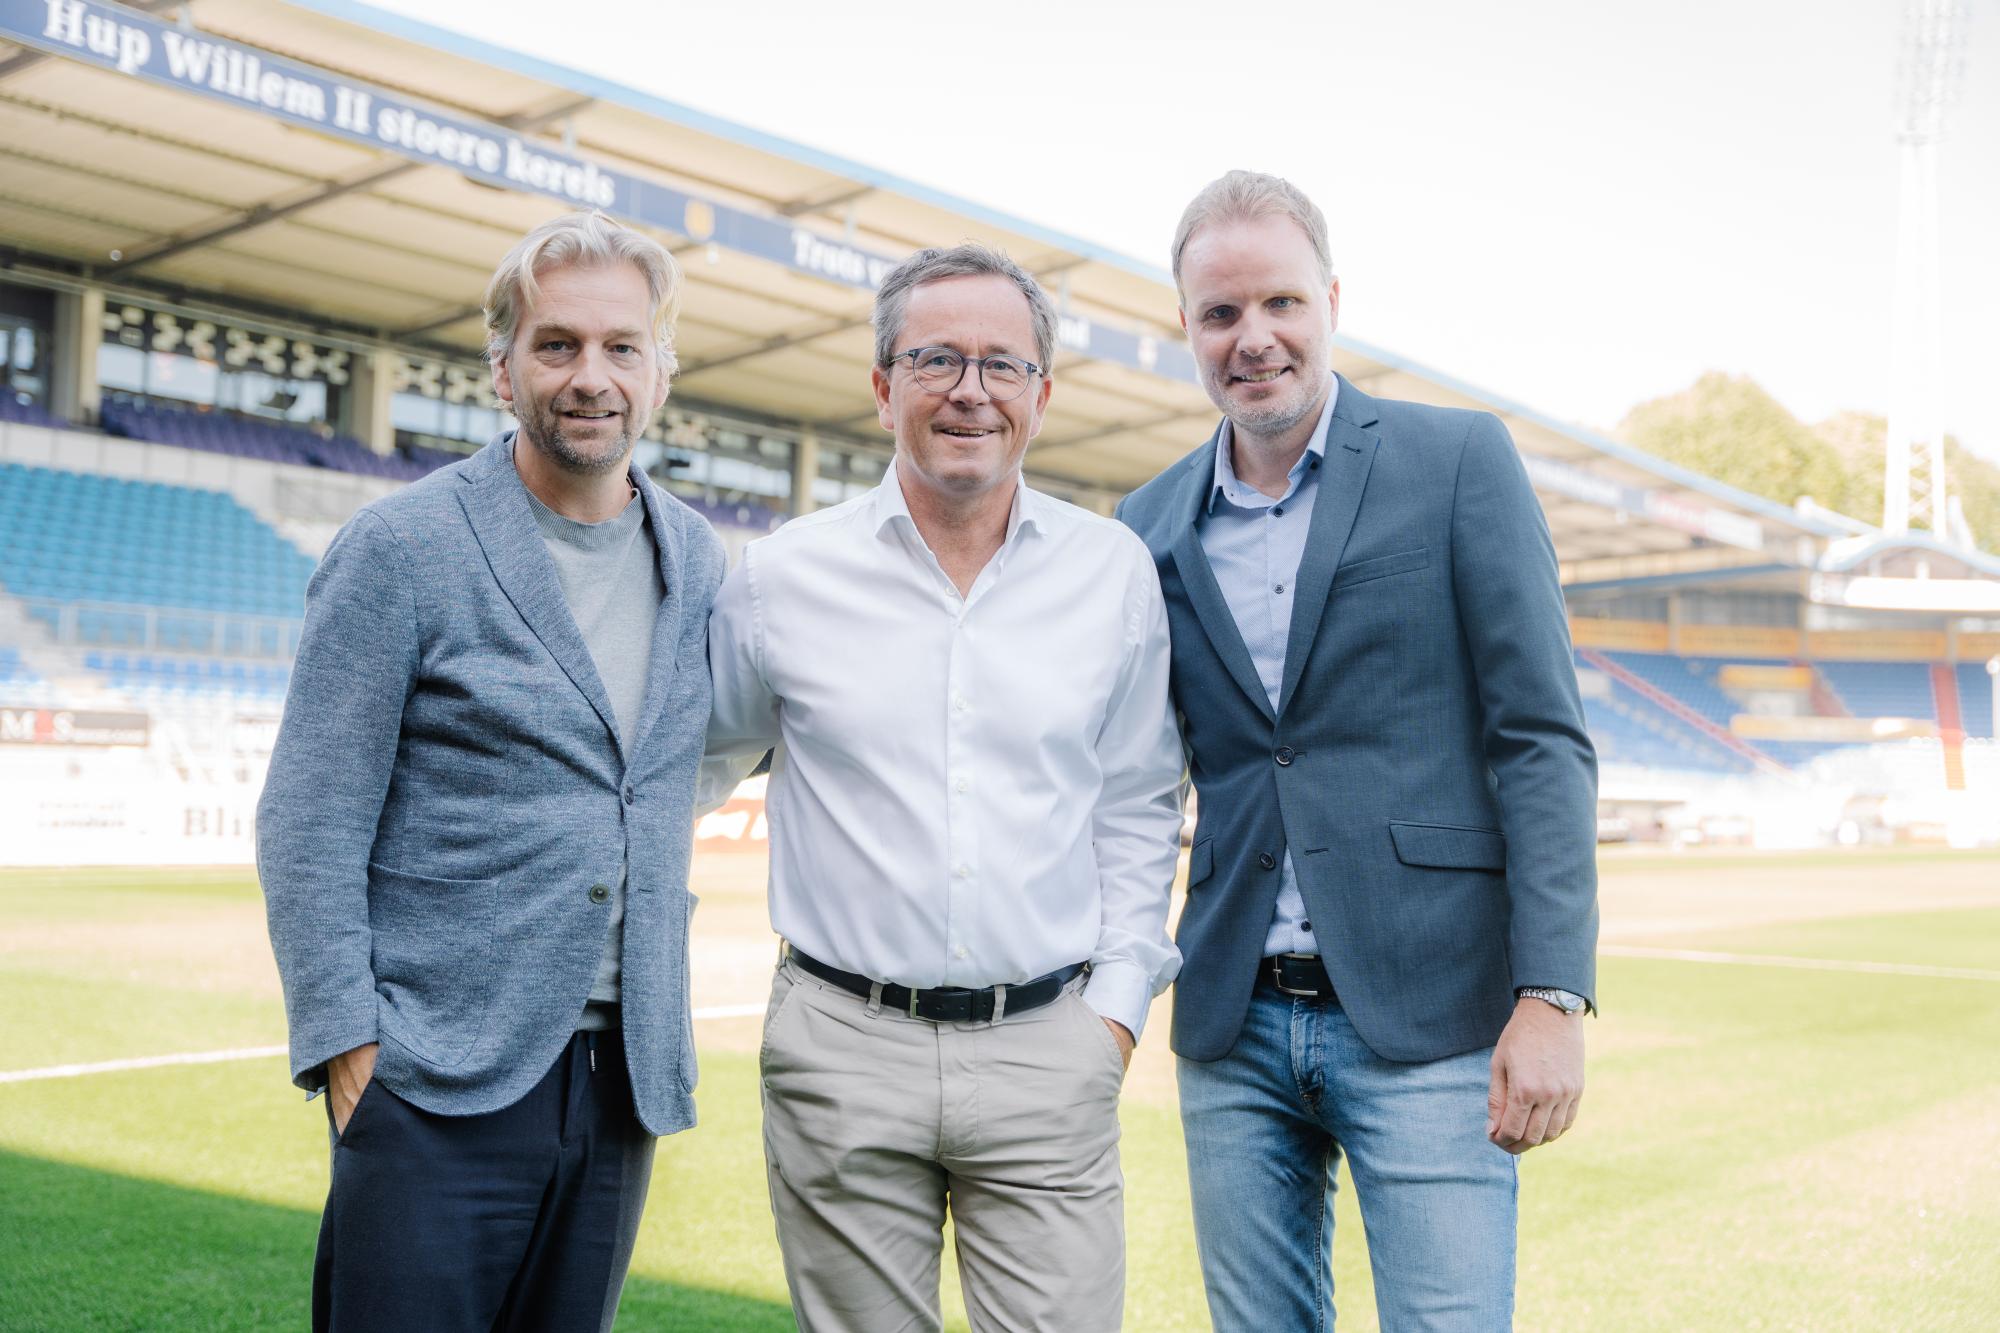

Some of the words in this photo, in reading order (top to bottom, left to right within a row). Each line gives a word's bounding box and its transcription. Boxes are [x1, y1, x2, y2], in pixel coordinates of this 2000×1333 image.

[42, 0, 150, 75] Hup
[161, 29, 327, 122] Willem
[333, 85, 371, 135] II
[377, 107, 501, 173] stoere
[504, 137, 616, 208] kerels
